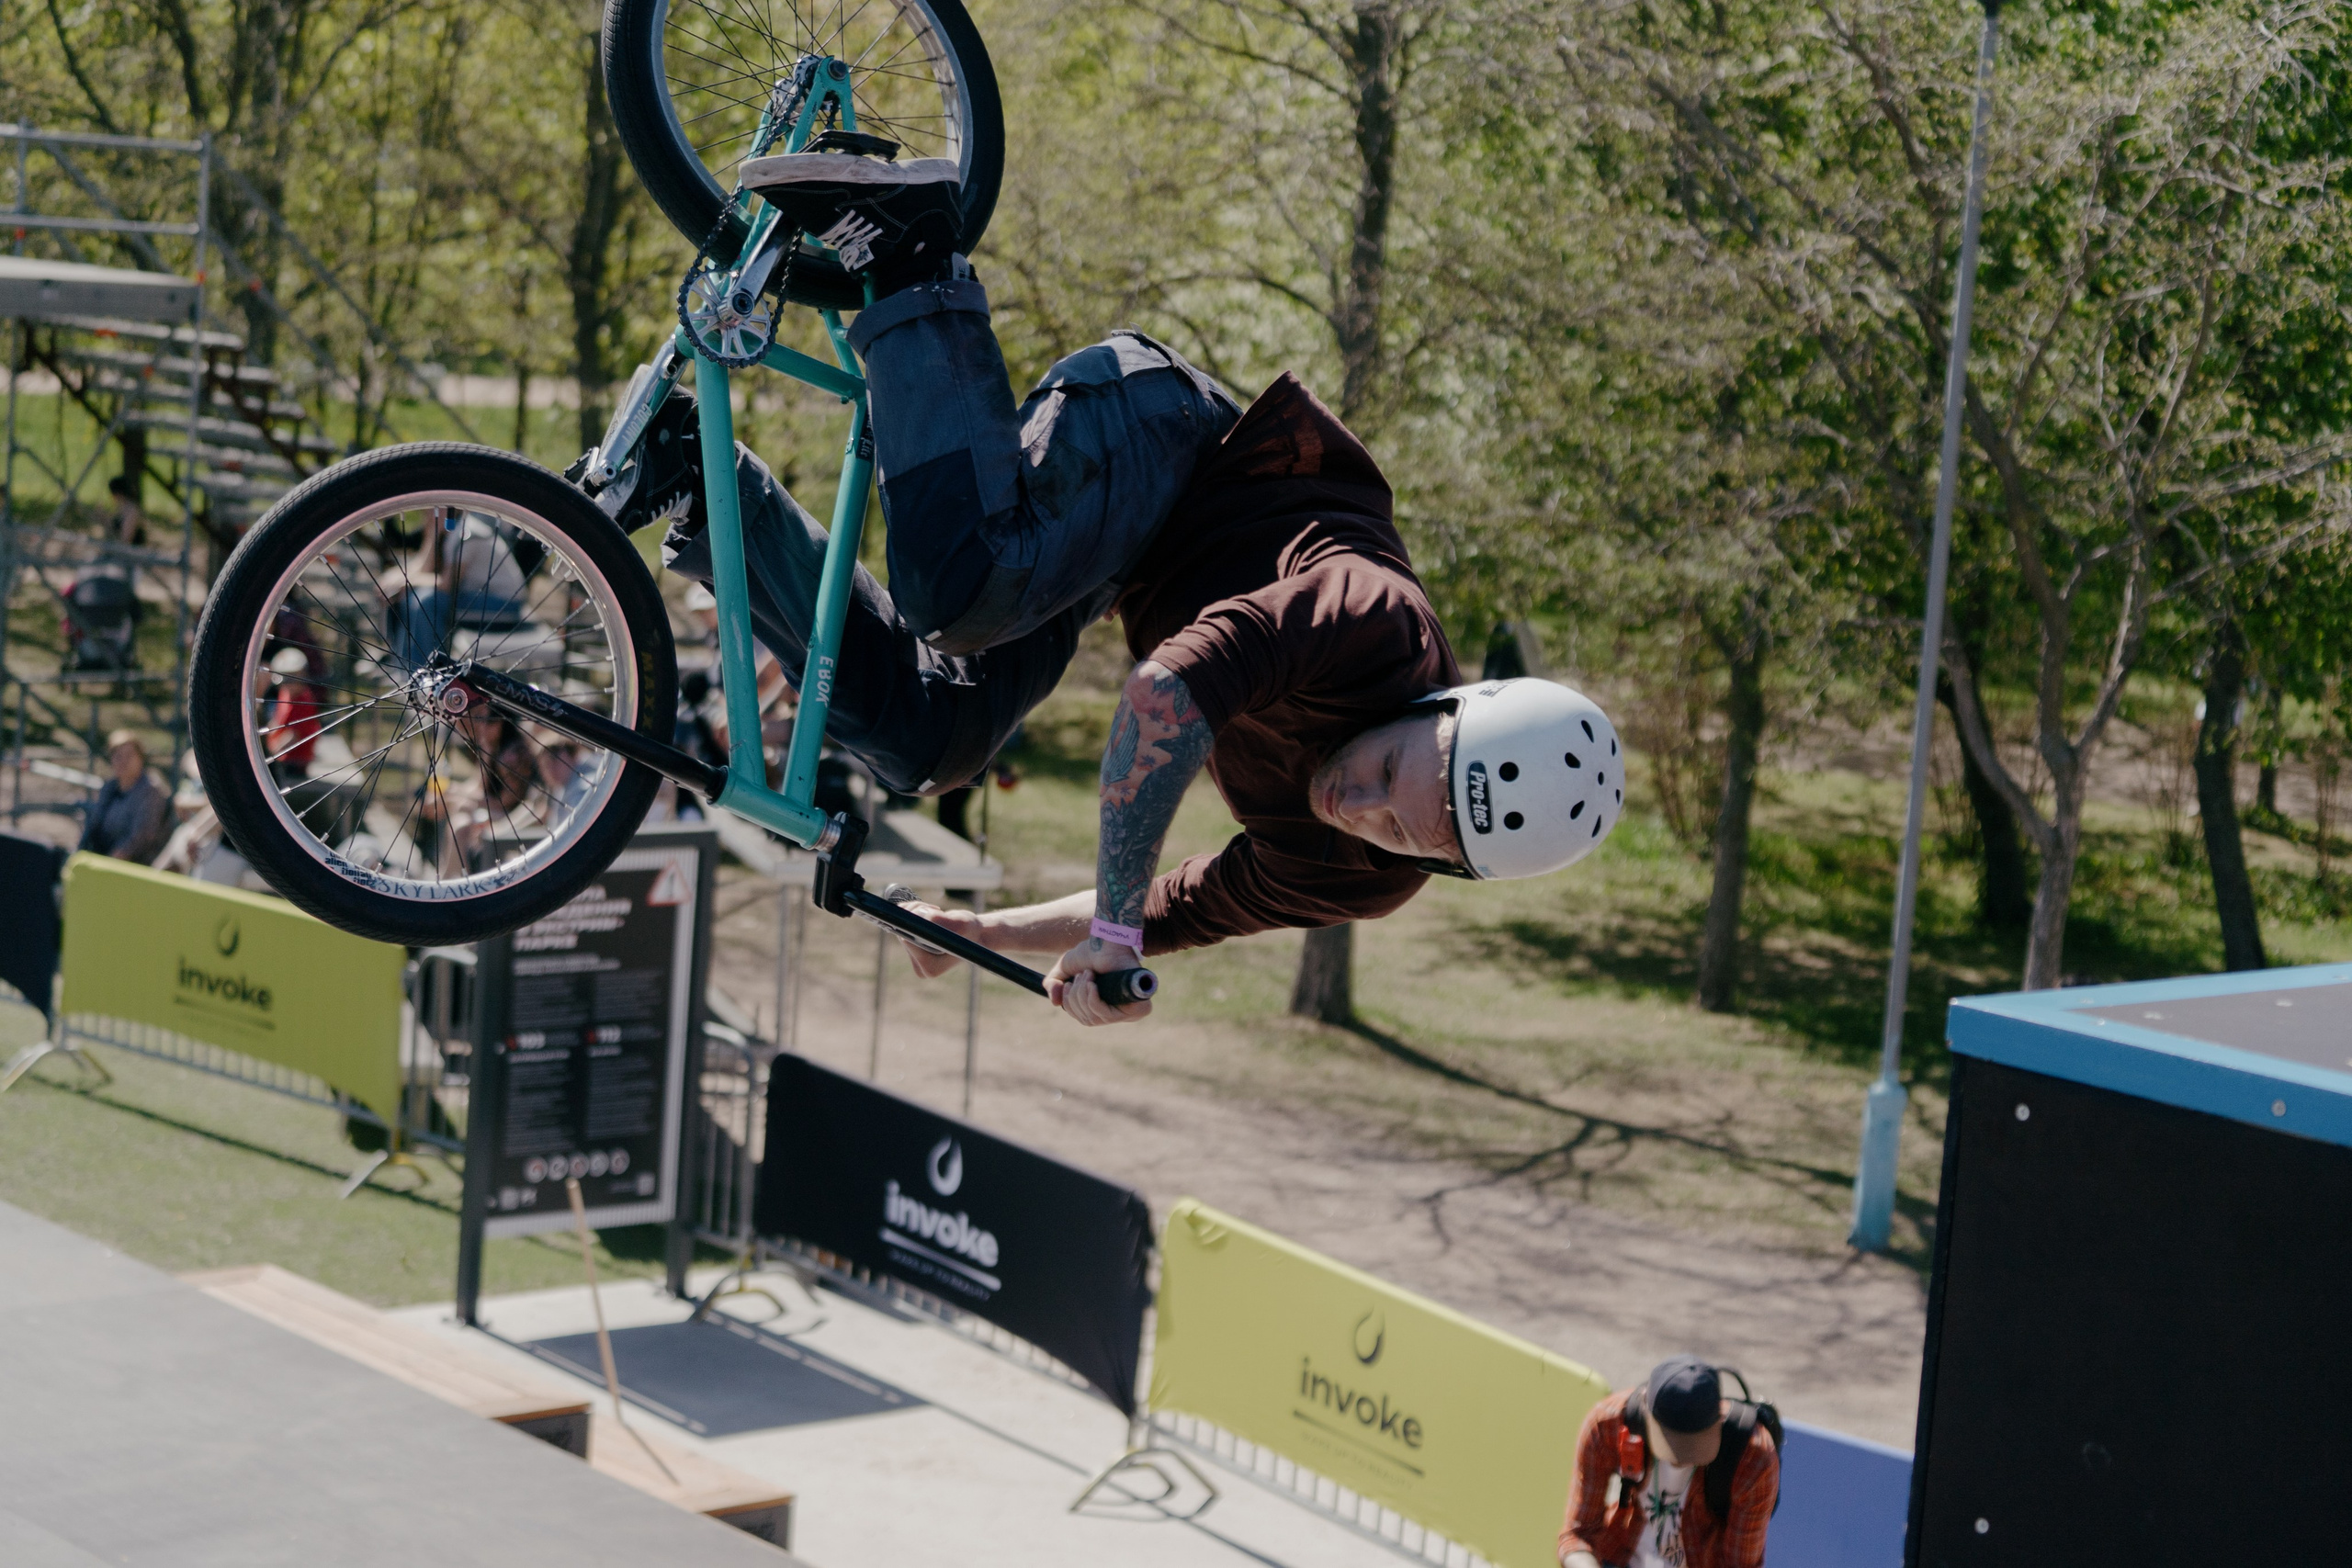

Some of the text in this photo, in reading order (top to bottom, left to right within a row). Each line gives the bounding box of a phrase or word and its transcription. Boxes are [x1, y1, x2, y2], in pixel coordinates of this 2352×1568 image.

[1470, 771, 1488, 828] Pro-tec
[378, 878, 489, 899] SKYLARK
[177, 955, 273, 1011] invoke
[885, 1179, 1000, 1268] invoke
[1300, 1355, 1423, 1449] invoke
